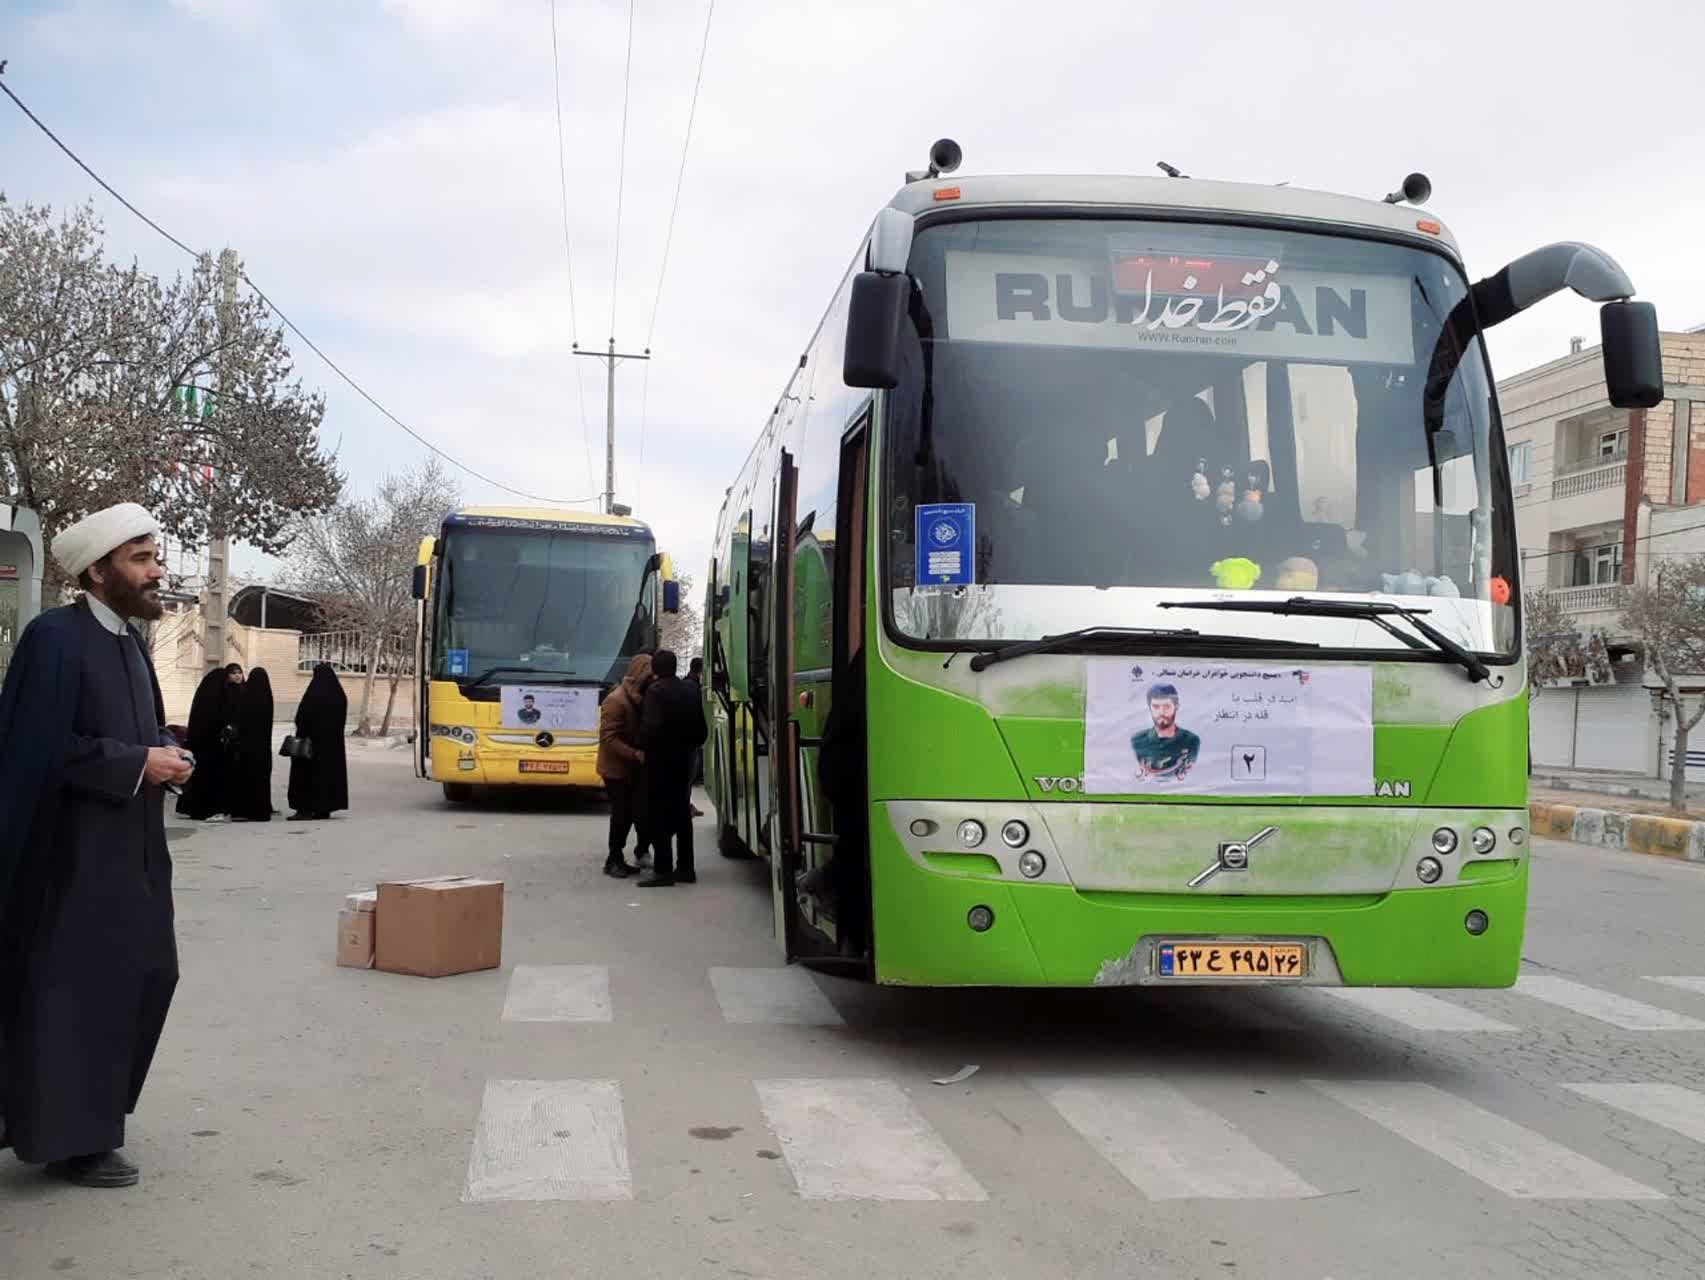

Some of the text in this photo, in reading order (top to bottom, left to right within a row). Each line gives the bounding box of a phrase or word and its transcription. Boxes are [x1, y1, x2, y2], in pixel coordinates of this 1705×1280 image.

[1131, 259, 1281, 331] فقط خدا
[1213, 707, 1240, 722] انتظار
[1243, 753, 1256, 775] ۲
